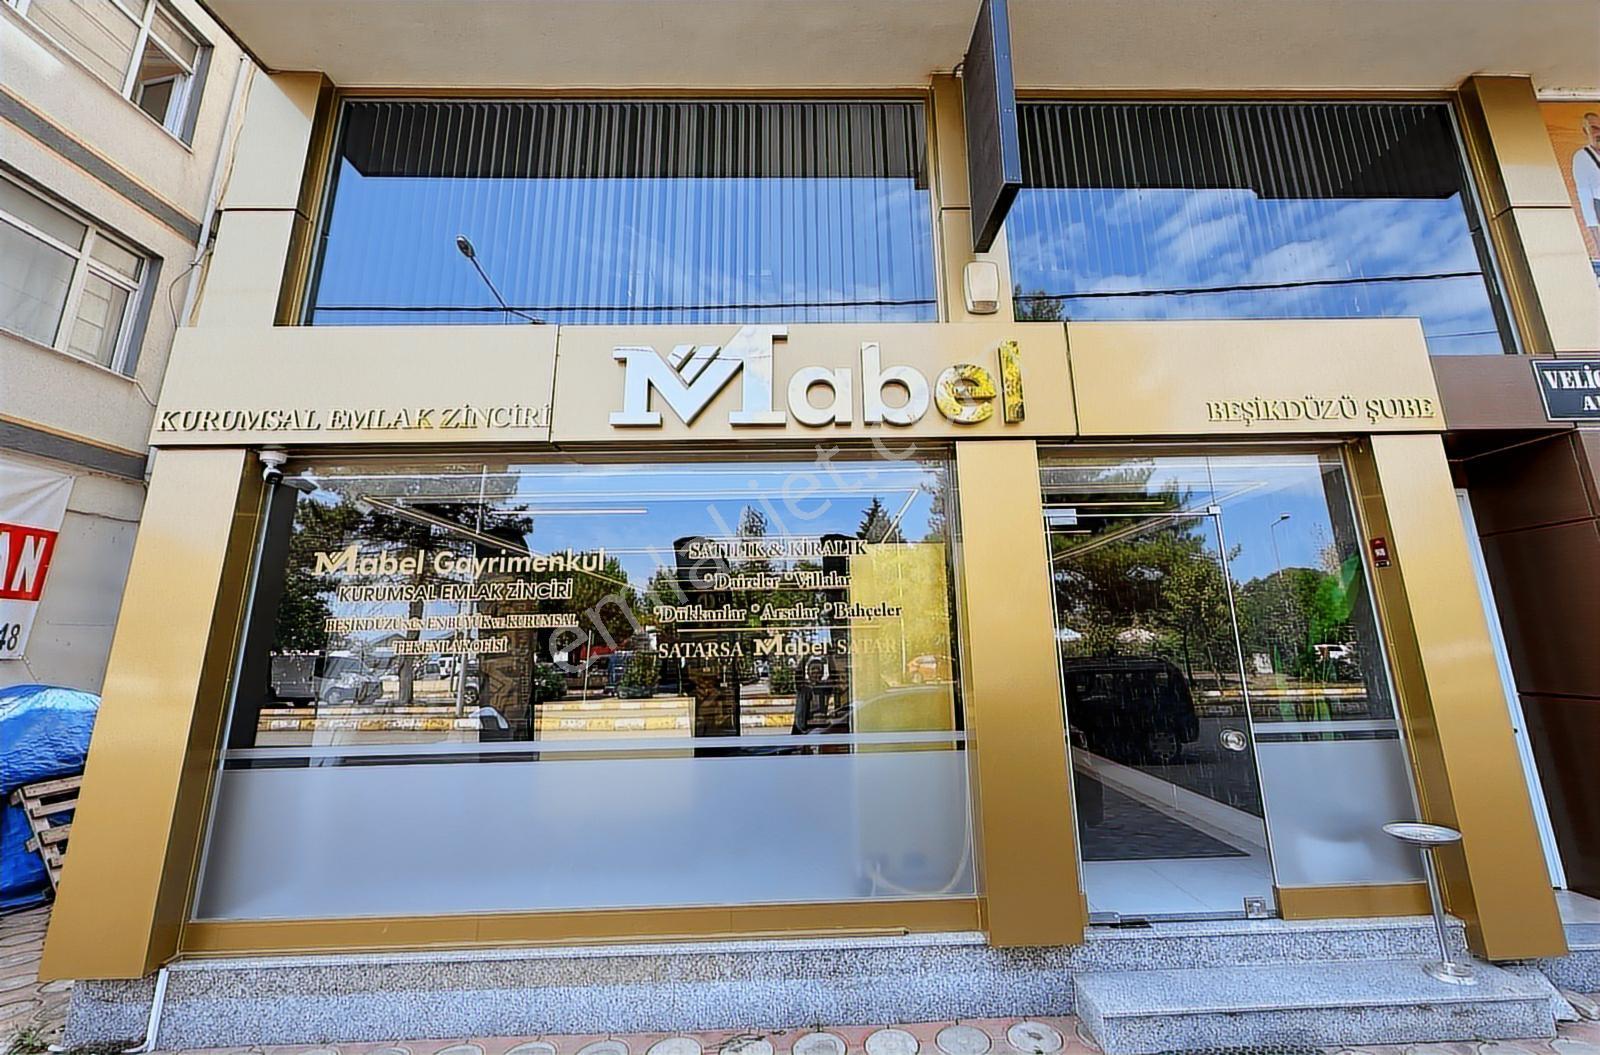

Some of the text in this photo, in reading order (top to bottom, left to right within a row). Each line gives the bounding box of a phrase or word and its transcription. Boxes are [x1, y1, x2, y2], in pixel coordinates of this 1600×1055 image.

[608, 324, 1026, 428] Mabel
[156, 401, 553, 432] KURUMSAL EMLAK ZİNCİRİ
[1205, 394, 1435, 426] BEŞİKDÜZÜ ŞUBE
[311, 544, 425, 576] Mabel
[688, 537, 869, 559] SATILIK & KİRALIK
[338, 577, 574, 602] KURUMSAL EMLAK ZİNCİRİ
[658, 641, 744, 659] SATARSA
